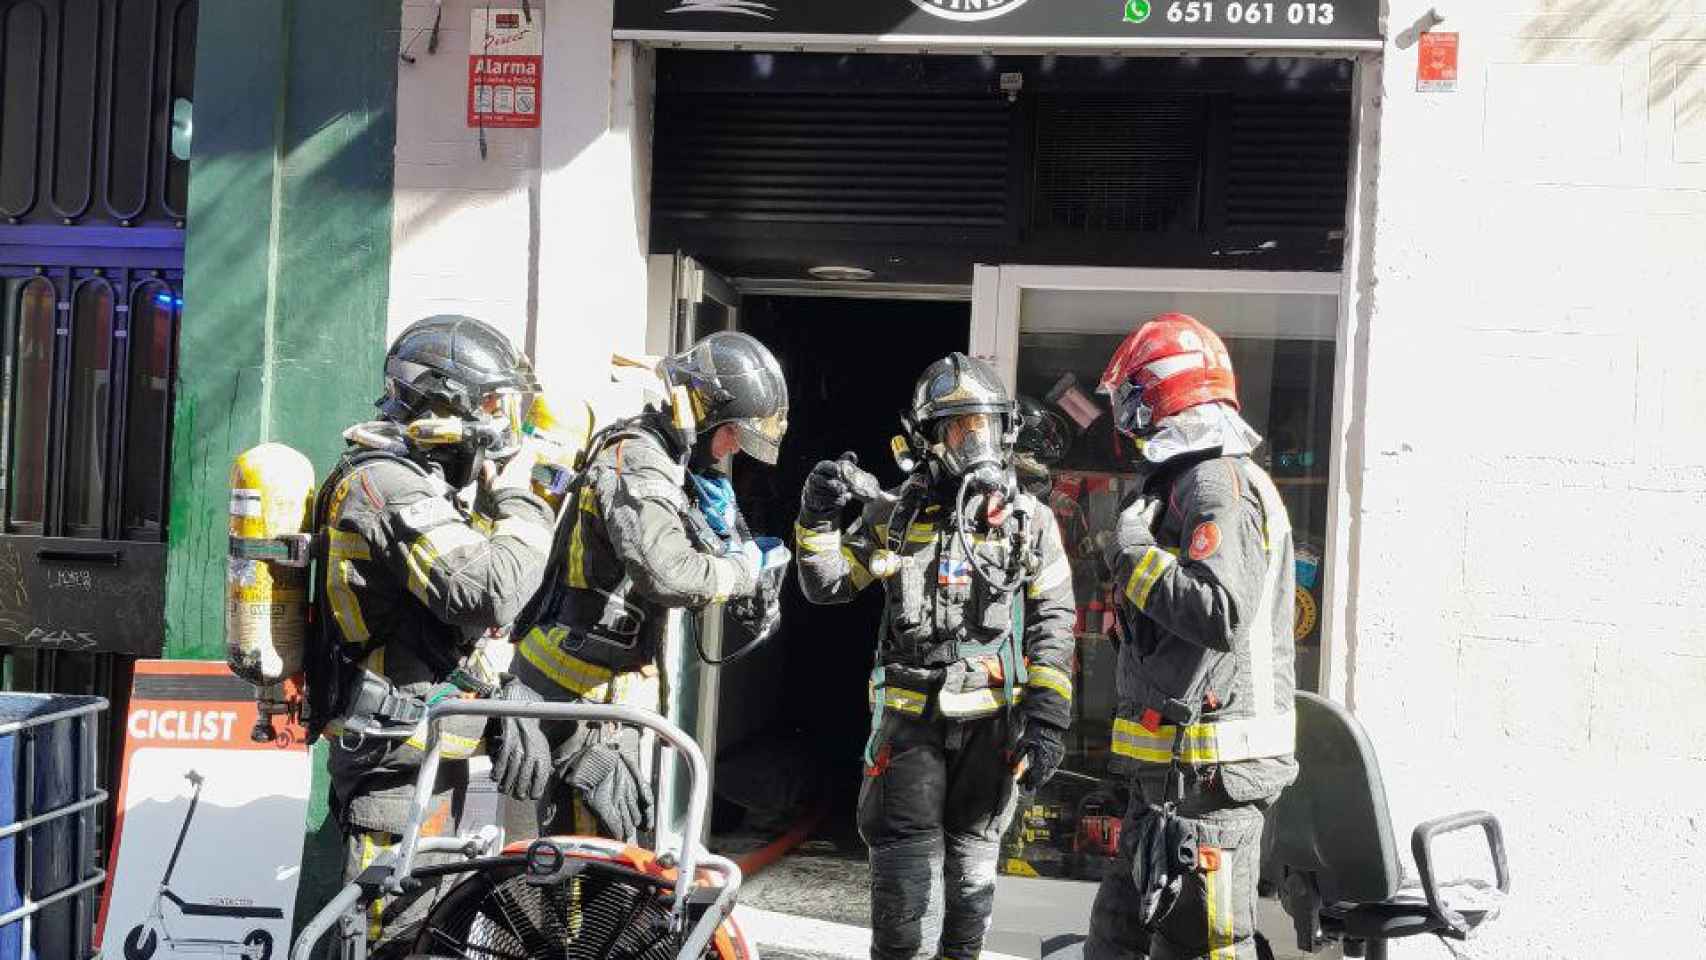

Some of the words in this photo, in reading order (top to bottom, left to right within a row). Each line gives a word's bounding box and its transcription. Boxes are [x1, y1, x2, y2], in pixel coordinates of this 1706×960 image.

[1167, 1, 1213, 22] 651
[1227, 2, 1273, 24] 061
[1287, 3, 1334, 25] 013
[474, 58, 535, 74] Alarma
[128, 709, 237, 740] CICLIST
